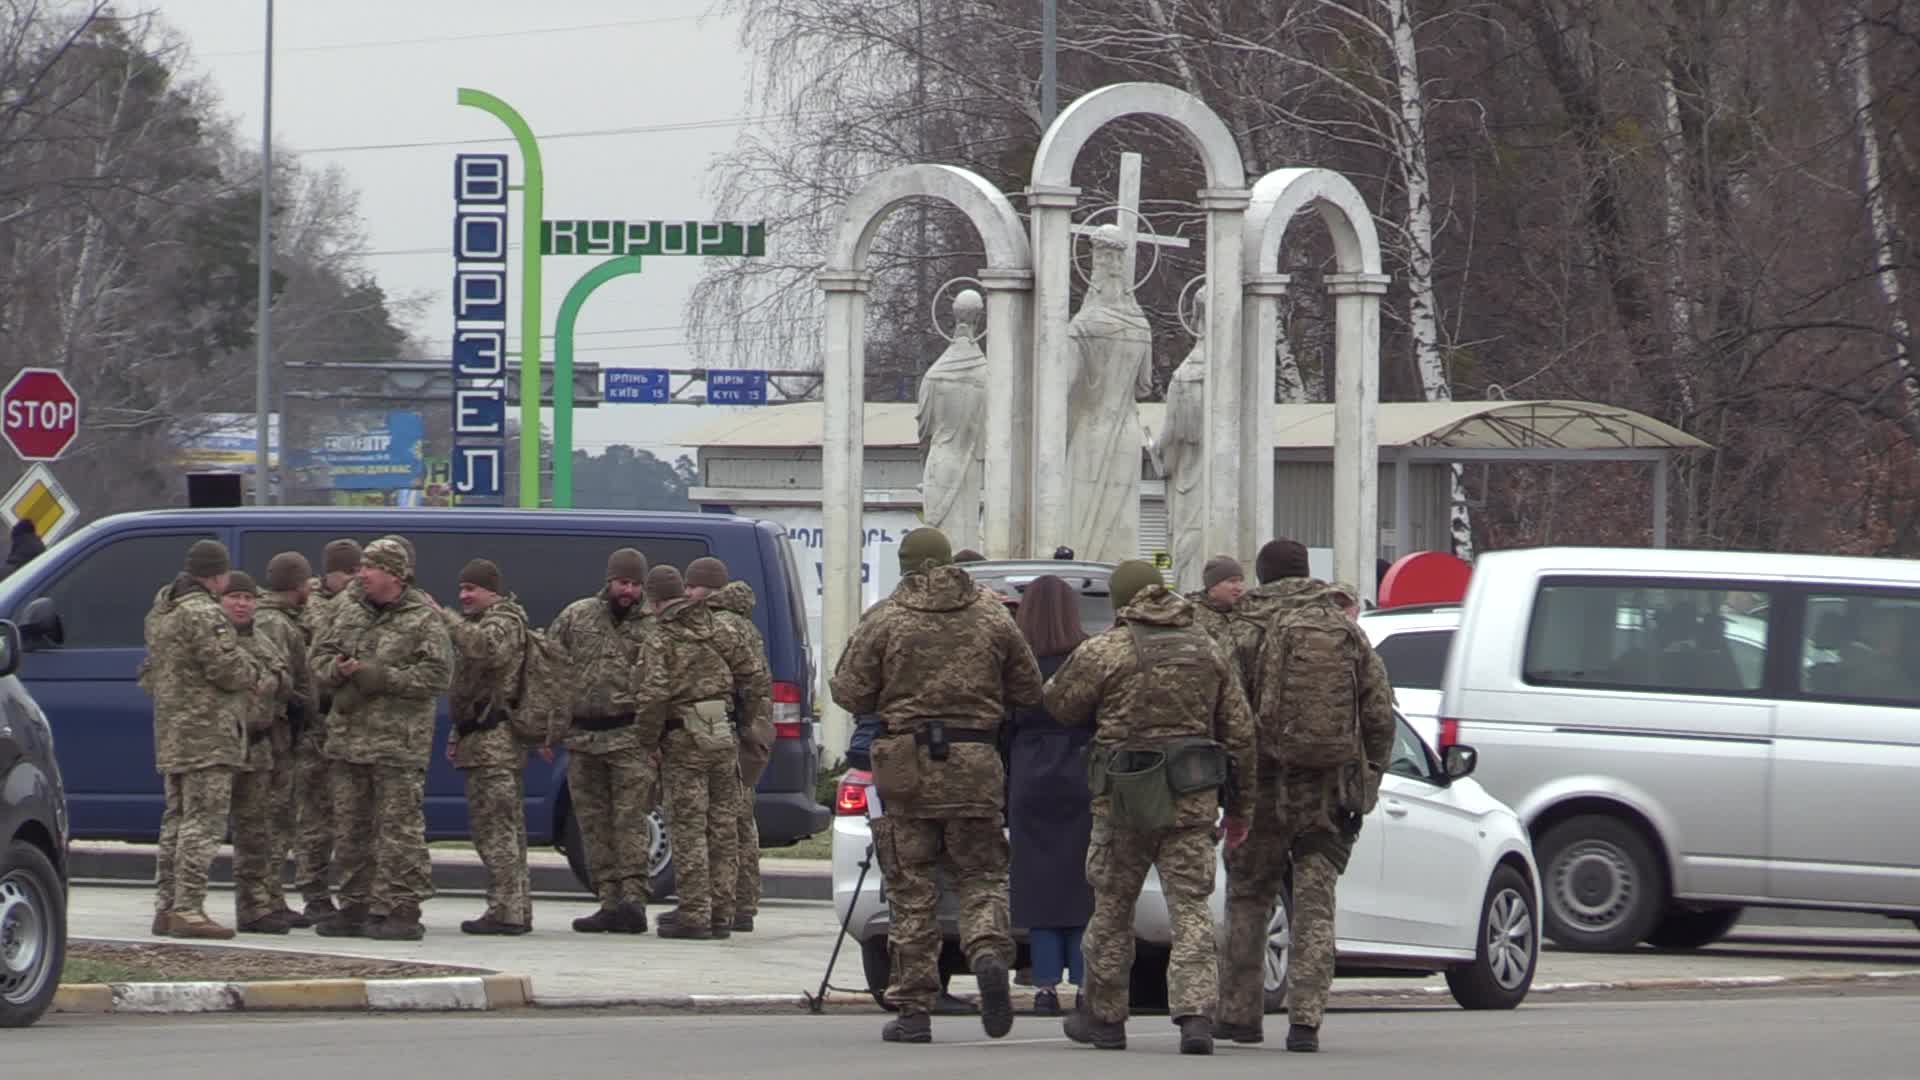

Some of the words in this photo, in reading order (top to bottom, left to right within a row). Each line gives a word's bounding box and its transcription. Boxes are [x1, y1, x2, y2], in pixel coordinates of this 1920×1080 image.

[551, 220, 761, 255] КУРОРТ
[456, 158, 504, 491] ВОРЗЕЛ
[609, 373, 649, 384] ІРПІНЬ
[657, 373, 665, 384] 7
[753, 375, 761, 385] 7
[609, 387, 639, 398] КИЇВ
[652, 388, 664, 398] 15
[7, 400, 73, 430] STOP
